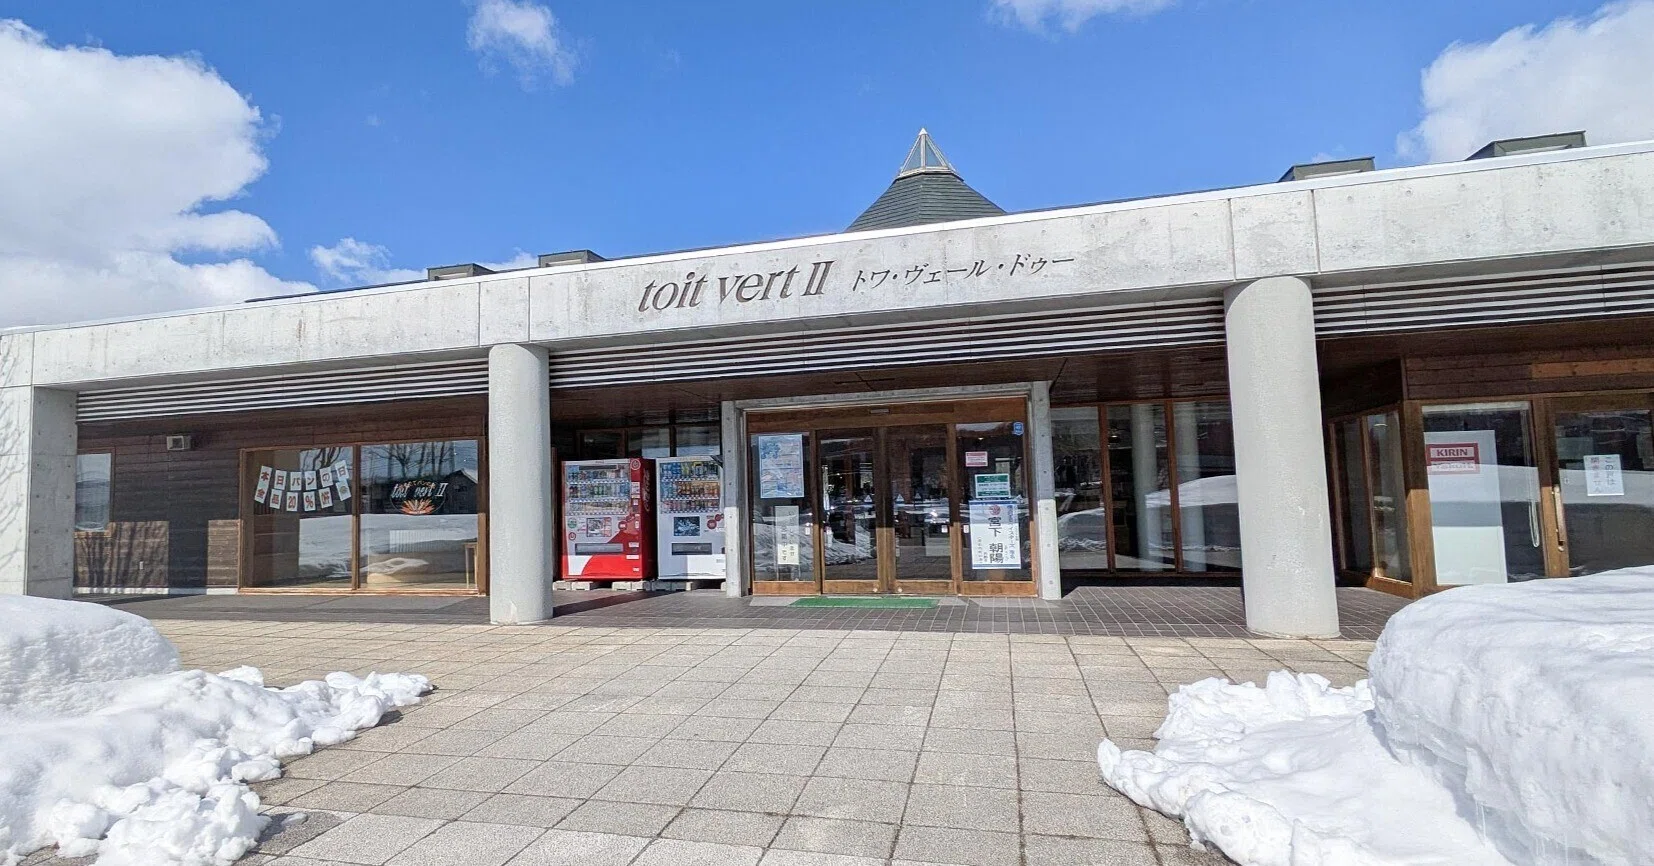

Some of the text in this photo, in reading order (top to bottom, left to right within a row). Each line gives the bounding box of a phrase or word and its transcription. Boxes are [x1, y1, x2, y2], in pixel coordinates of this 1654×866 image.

[638, 271, 708, 312] toit
[718, 264, 800, 304] vert
[852, 253, 1075, 292] トワ・ヴェール・ドゥー
[1436, 448, 1468, 457] KIRIN
[988, 516, 1004, 564] 宮下 朝陽
